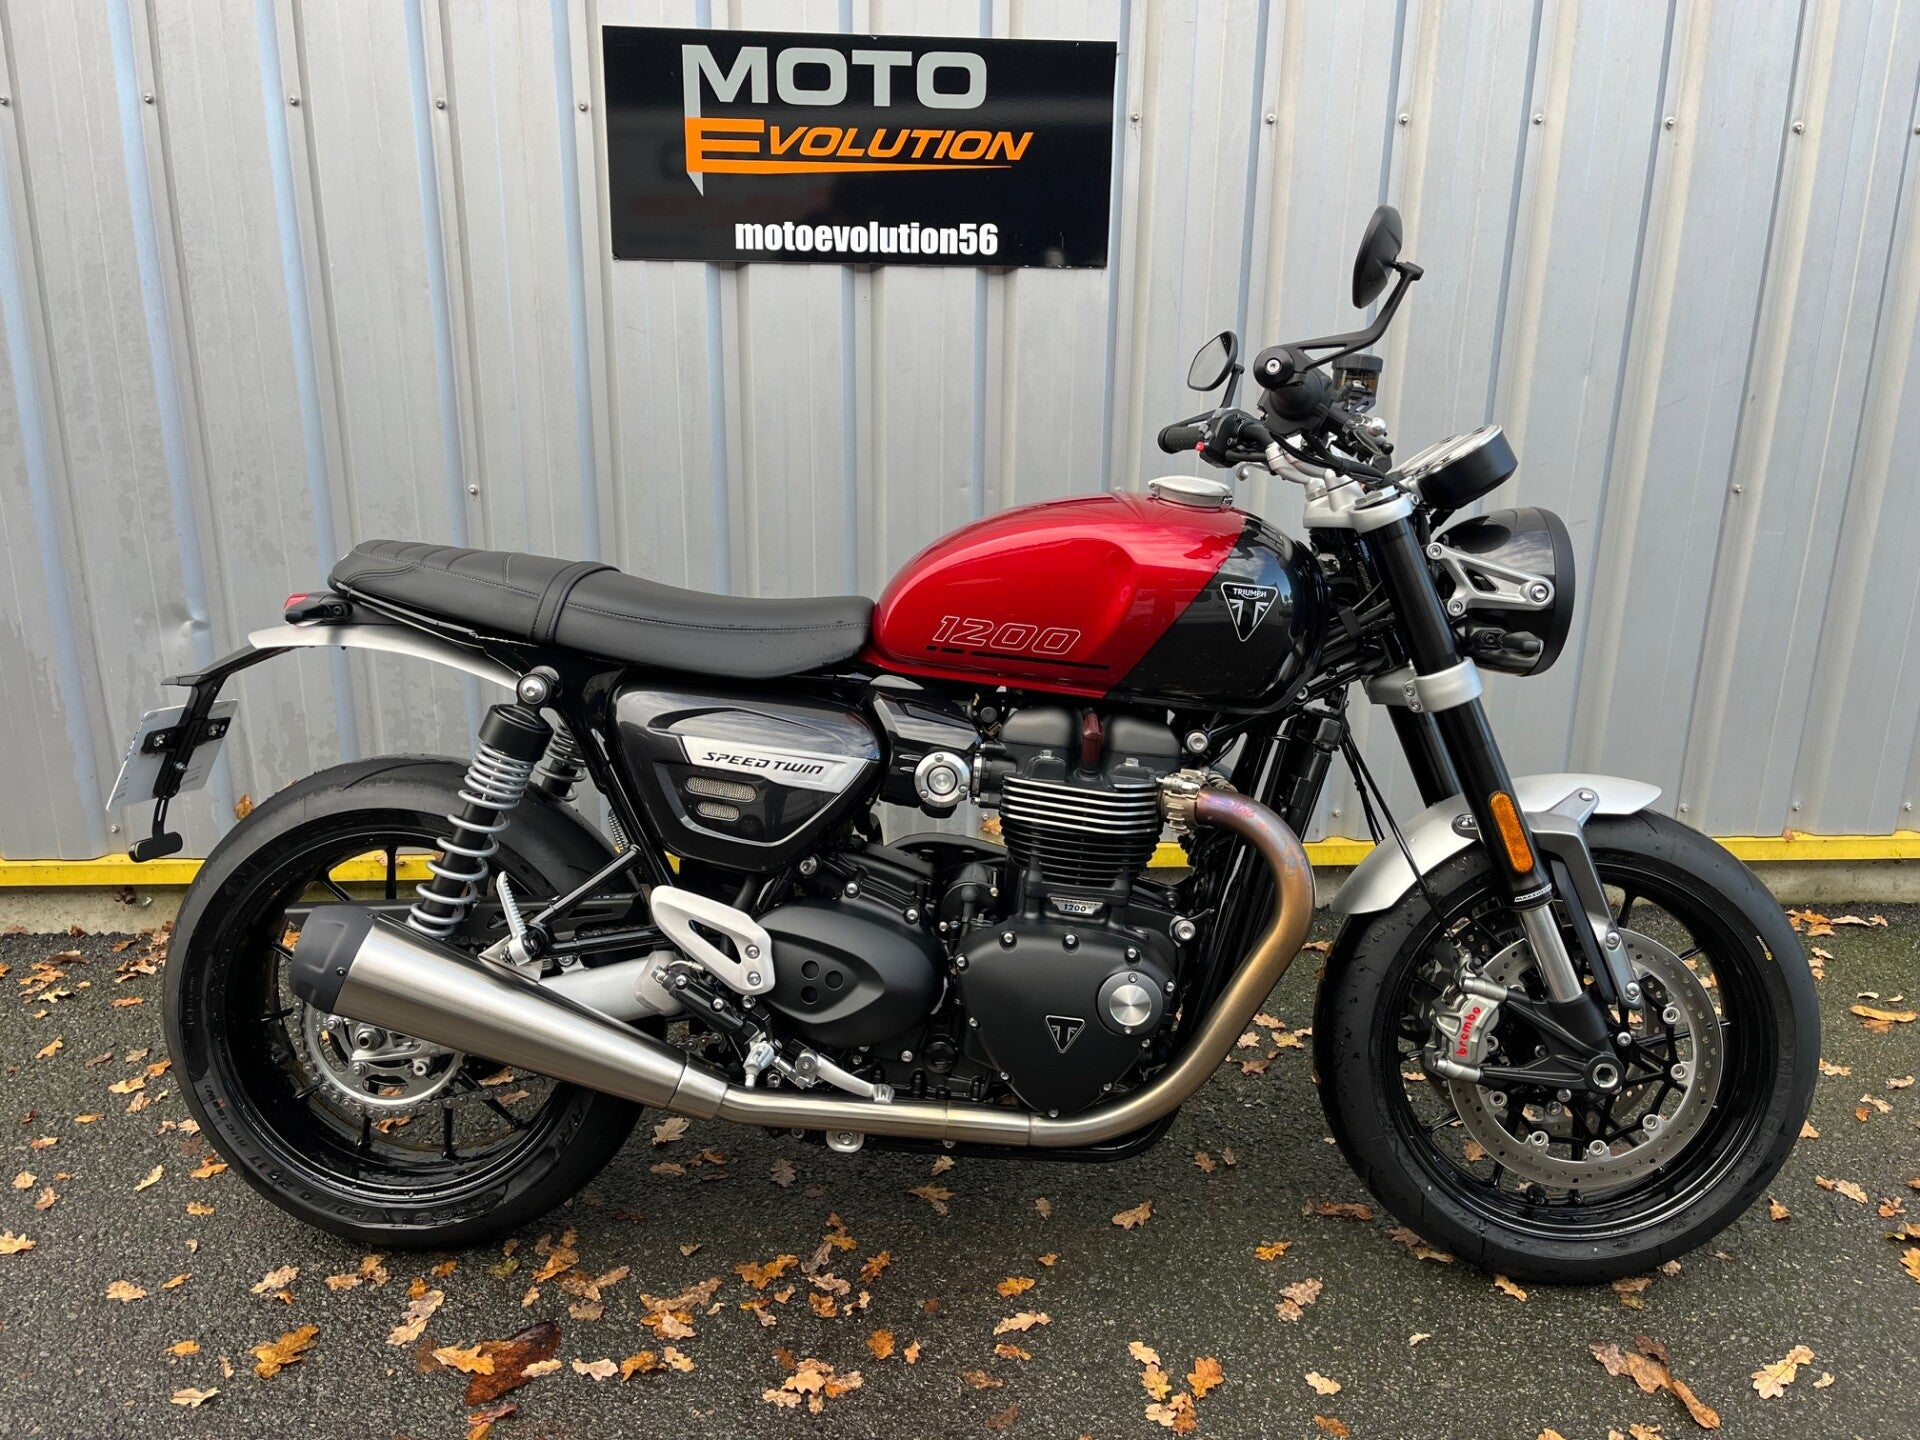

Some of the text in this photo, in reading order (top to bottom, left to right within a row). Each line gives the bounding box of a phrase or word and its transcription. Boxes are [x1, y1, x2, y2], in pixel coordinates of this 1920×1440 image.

[682, 44, 988, 109] MOTO
[685, 117, 1034, 174] EVOLUTION
[735, 221, 999, 256] motoevolution56
[1233, 587, 1268, 599] TRIUMPH
[932, 615, 1081, 656] 1200
[702, 751, 825, 775] SPEED TWIN
[1064, 903, 1087, 912] 1200
[1456, 1006, 1482, 1057] brembo
